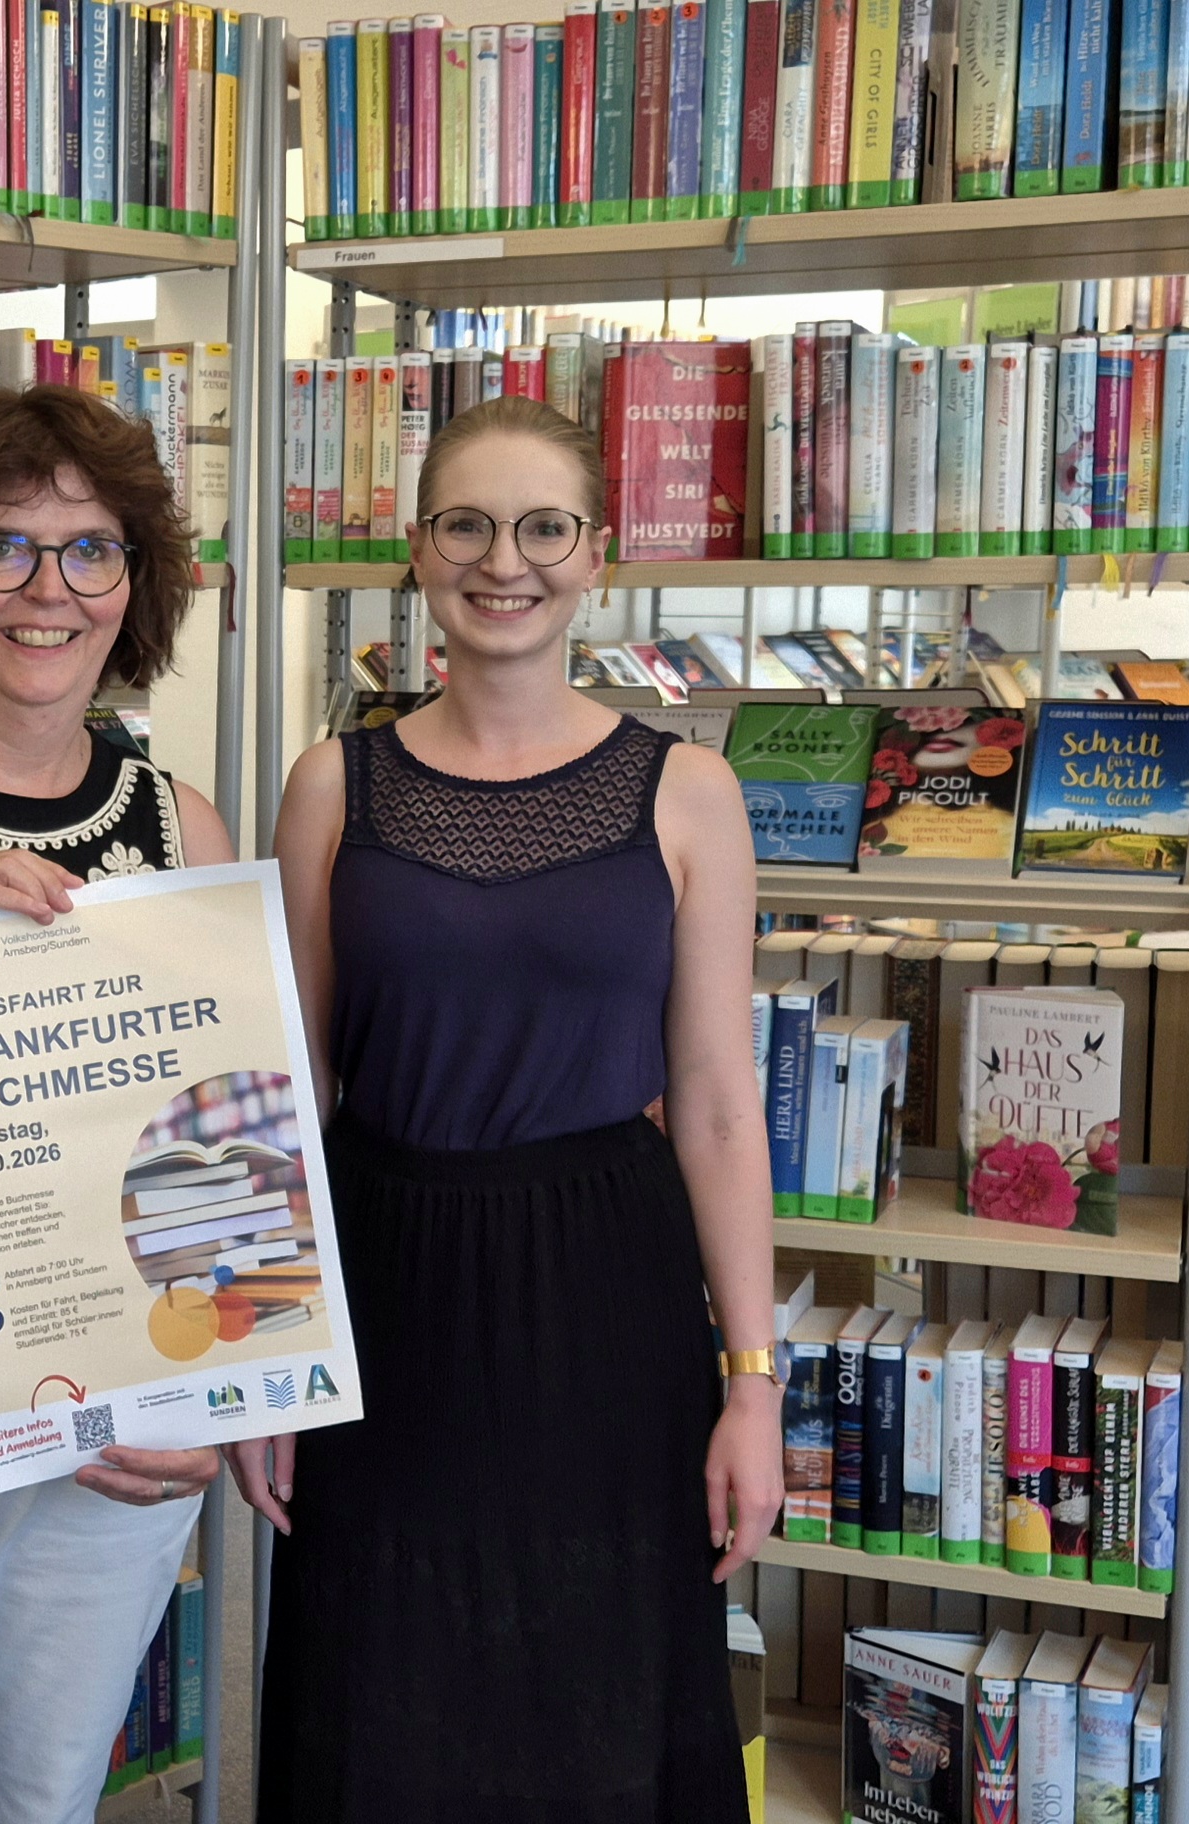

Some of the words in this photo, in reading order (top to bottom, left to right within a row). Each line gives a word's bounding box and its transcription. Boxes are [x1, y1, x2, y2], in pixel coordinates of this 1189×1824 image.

[1076, 29, 1089, 60] Hitze
[1089, 24, 1102, 53] nicht
[93, 7, 106, 98] SHRIVER
[869, 48, 882, 78] CITY
[13, 90, 21, 121] JULIA
[867, 84, 879, 101] OF
[748, 109, 758, 140] NINA
[758, 96, 770, 151] GEORGE
[782, 100, 793, 138] CIARA
[865, 109, 878, 148] GIRLS
[971, 103, 983, 156] JOANNE
[984, 101, 996, 151] HARRIS
[1079, 112, 1091, 139] Dora
[93, 106, 106, 179] LIONEL
[334, 250, 376, 263] Frauen
[353, 370, 364, 383] 3
[672, 365, 704, 381] DIE
[165, 373, 177, 470] Zuckermann
[626, 404, 749, 421] GLEISSENDE
[659, 444, 712, 460] WELT
[664, 483, 704, 499] SIRI
[954, 472, 964, 521] CARMEN
[996, 470, 1007, 520] CARMEN
[631, 522, 736, 540] HUSTVEDT
[769, 729, 833, 741] SALLY
[1059, 728, 1164, 758] Schritt
[752, 742, 846, 755] ROONEY
[1060, 762, 1167, 790] Schritt
[1106, 755, 1135, 772] für
[918, 775, 972, 790] JODI
[897, 791, 990, 806] PICOULT
[1063, 793, 1098, 806] zum
[1105, 791, 1153, 807] Glück
[748, 808, 841, 822] ORMALE
[752, 822, 846, 836] NSCHEN
[0, 925, 81, 945] Volkshochschule
[3, 936, 91, 958] Arnsberg/Sundern
[93, 974, 143, 1000] ZUR
[989, 1005, 1040, 1020] PAULINE
[1043, 1010, 1101, 1024] LAMBERT
[1024, 1027, 1062, 1048] DAS
[778, 1044, 794, 1089] LIND
[1004, 1047, 1083, 1084] HAUS
[1024, 1080, 1061, 1102] DER
[775, 1092, 792, 1141] HERA
[988, 1094, 1094, 1139] DÜFTE
[0, 1204, 33, 1218] erwartet
[34, 1201, 50, 1211] Sie:
[5, 1189, 55, 1205] Buchmesse
[15, 1225, 42, 1238] treffen
[43, 1221, 60, 1233] und
[19, 1210, 66, 1226] entdecken,
[12, 1237, 46, 1251] erleben.
[4, 1266, 34, 1280] Abfahrt
[35, 1264, 47, 1275] ab
[48, 1260, 67, 1271] 7:00
[68, 1257, 84, 1267] Uhr
[5, 1283, 14, 1292] in
[15, 1275, 53, 1290] Arnsberg
[54, 1270, 70, 1282] und
[72, 1264, 108, 1278] Sundern
[9, 1303, 39, 1316] Kosten
[40, 1299, 52, 1310] für
[53, 1294, 79, 1306] Fahrt,
[79, 1285, 124, 1301] Begleitung
[11, 1316, 28, 1327] und
[29, 1311, 58, 1323] Eintritt:
[59, 1307, 72, 1317] 85
[72, 1305, 79, 1314] €
[14, 1323, 51, 1339] ermäßigt
[51, 1320, 63, 1330] für
[64, 1308, 124, 1328] Schüler:innen/
[15, 1333, 67, 1350] Studierende:
[69, 1328, 81, 1338] 75
[81, 1326, 88, 1336] €
[966, 1376, 977, 1415] Judith
[1018, 1378, 1029, 1398] DES
[208, 1405, 247, 1418] SUNDERN
[1018, 1399, 1029, 1431] KUNST
[1103, 1402, 1117, 1443] EINEM
[26, 1418, 54, 1433] Infos
[987, 1393, 1005, 1479] JESOLO
[6, 1431, 62, 1455] Anmeldung
[1018, 1431, 1029, 1449] DIE
[1103, 1448, 1115, 1474] AUF
[1119, 1438, 1131, 1479] STERN
[1102, 1478, 1114, 1551] VIELLEICHT
[1118, 1483, 1129, 1541] ANDEREN
[855, 1648, 896, 1672] ANNE
[902, 1663, 951, 1691] SAUER
[180, 1680, 192, 1731] AMELIE
[191, 1675, 201, 1717] FRIED
[864, 1780, 887, 1802] Im
[887, 1789, 940, 1823] Leben
